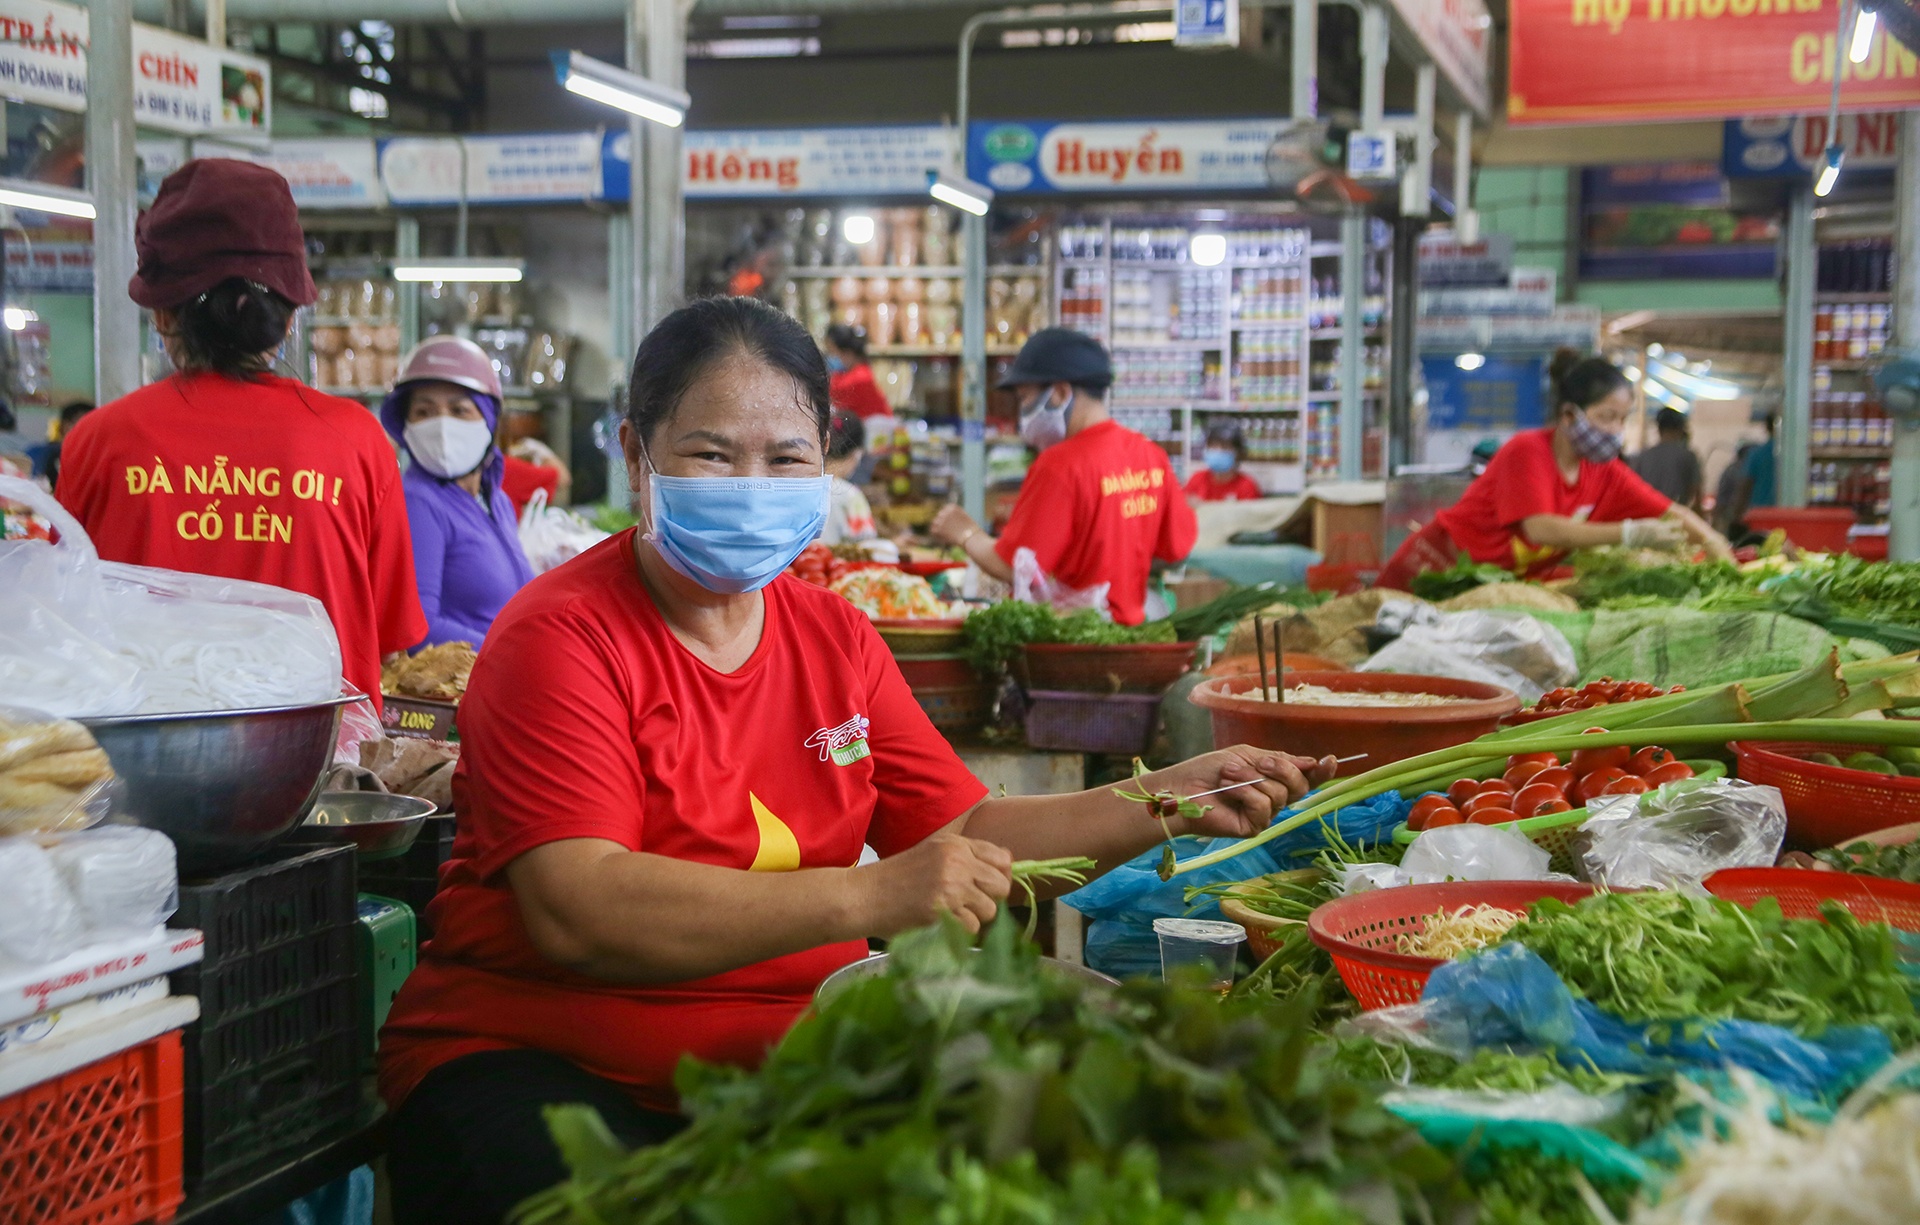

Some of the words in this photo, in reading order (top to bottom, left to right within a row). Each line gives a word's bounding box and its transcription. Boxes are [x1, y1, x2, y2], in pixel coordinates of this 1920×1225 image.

[125, 455, 174, 495] ĐÀ
[184, 455, 280, 497] NẴNG
[292, 469, 325, 502] ƠI
[177, 499, 224, 541] CỐ
[235, 504, 293, 544] LÊN
[400, 710, 436, 730] LONG
